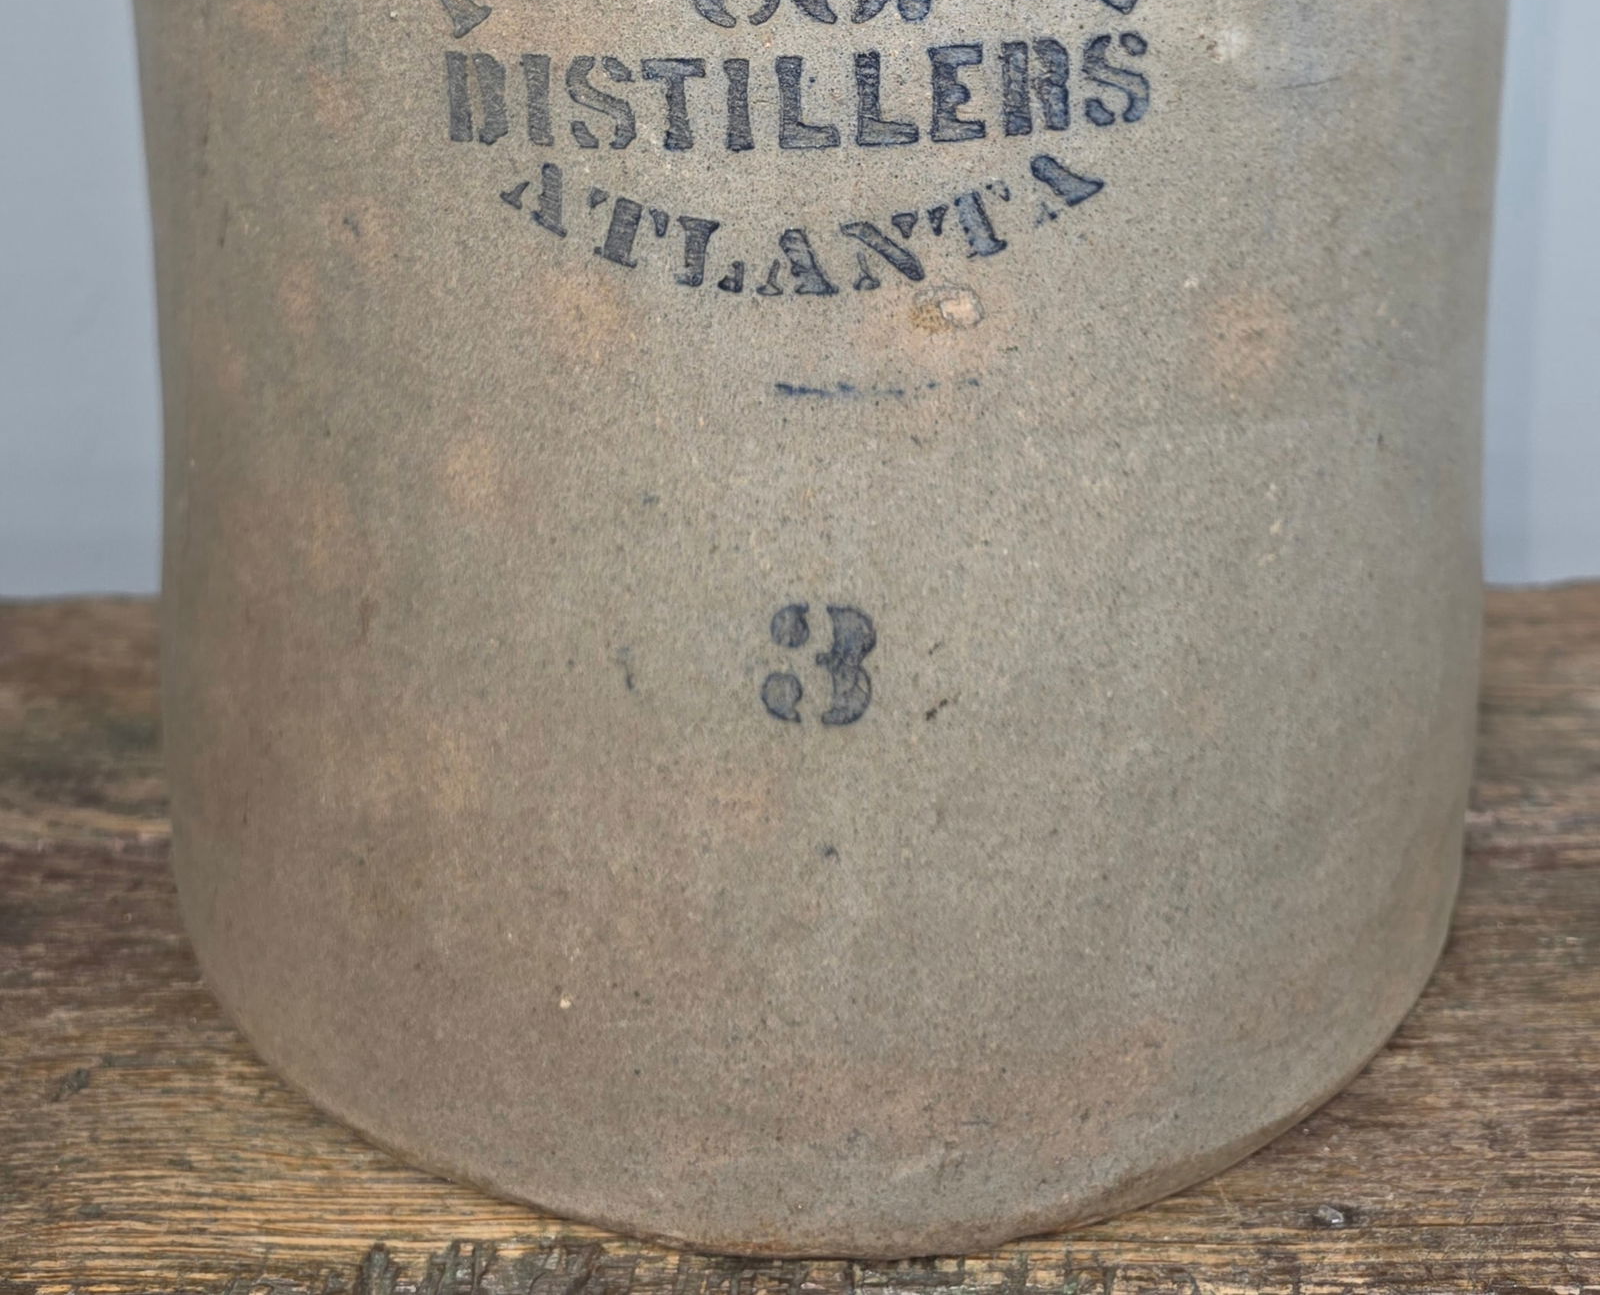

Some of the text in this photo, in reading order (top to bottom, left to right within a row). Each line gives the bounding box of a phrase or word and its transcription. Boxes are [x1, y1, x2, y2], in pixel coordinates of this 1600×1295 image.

[445, 31, 1151, 151] DISTILLERS
[500, 153, 1104, 299] ATLANTA
[760, 603, 878, 727] 3
